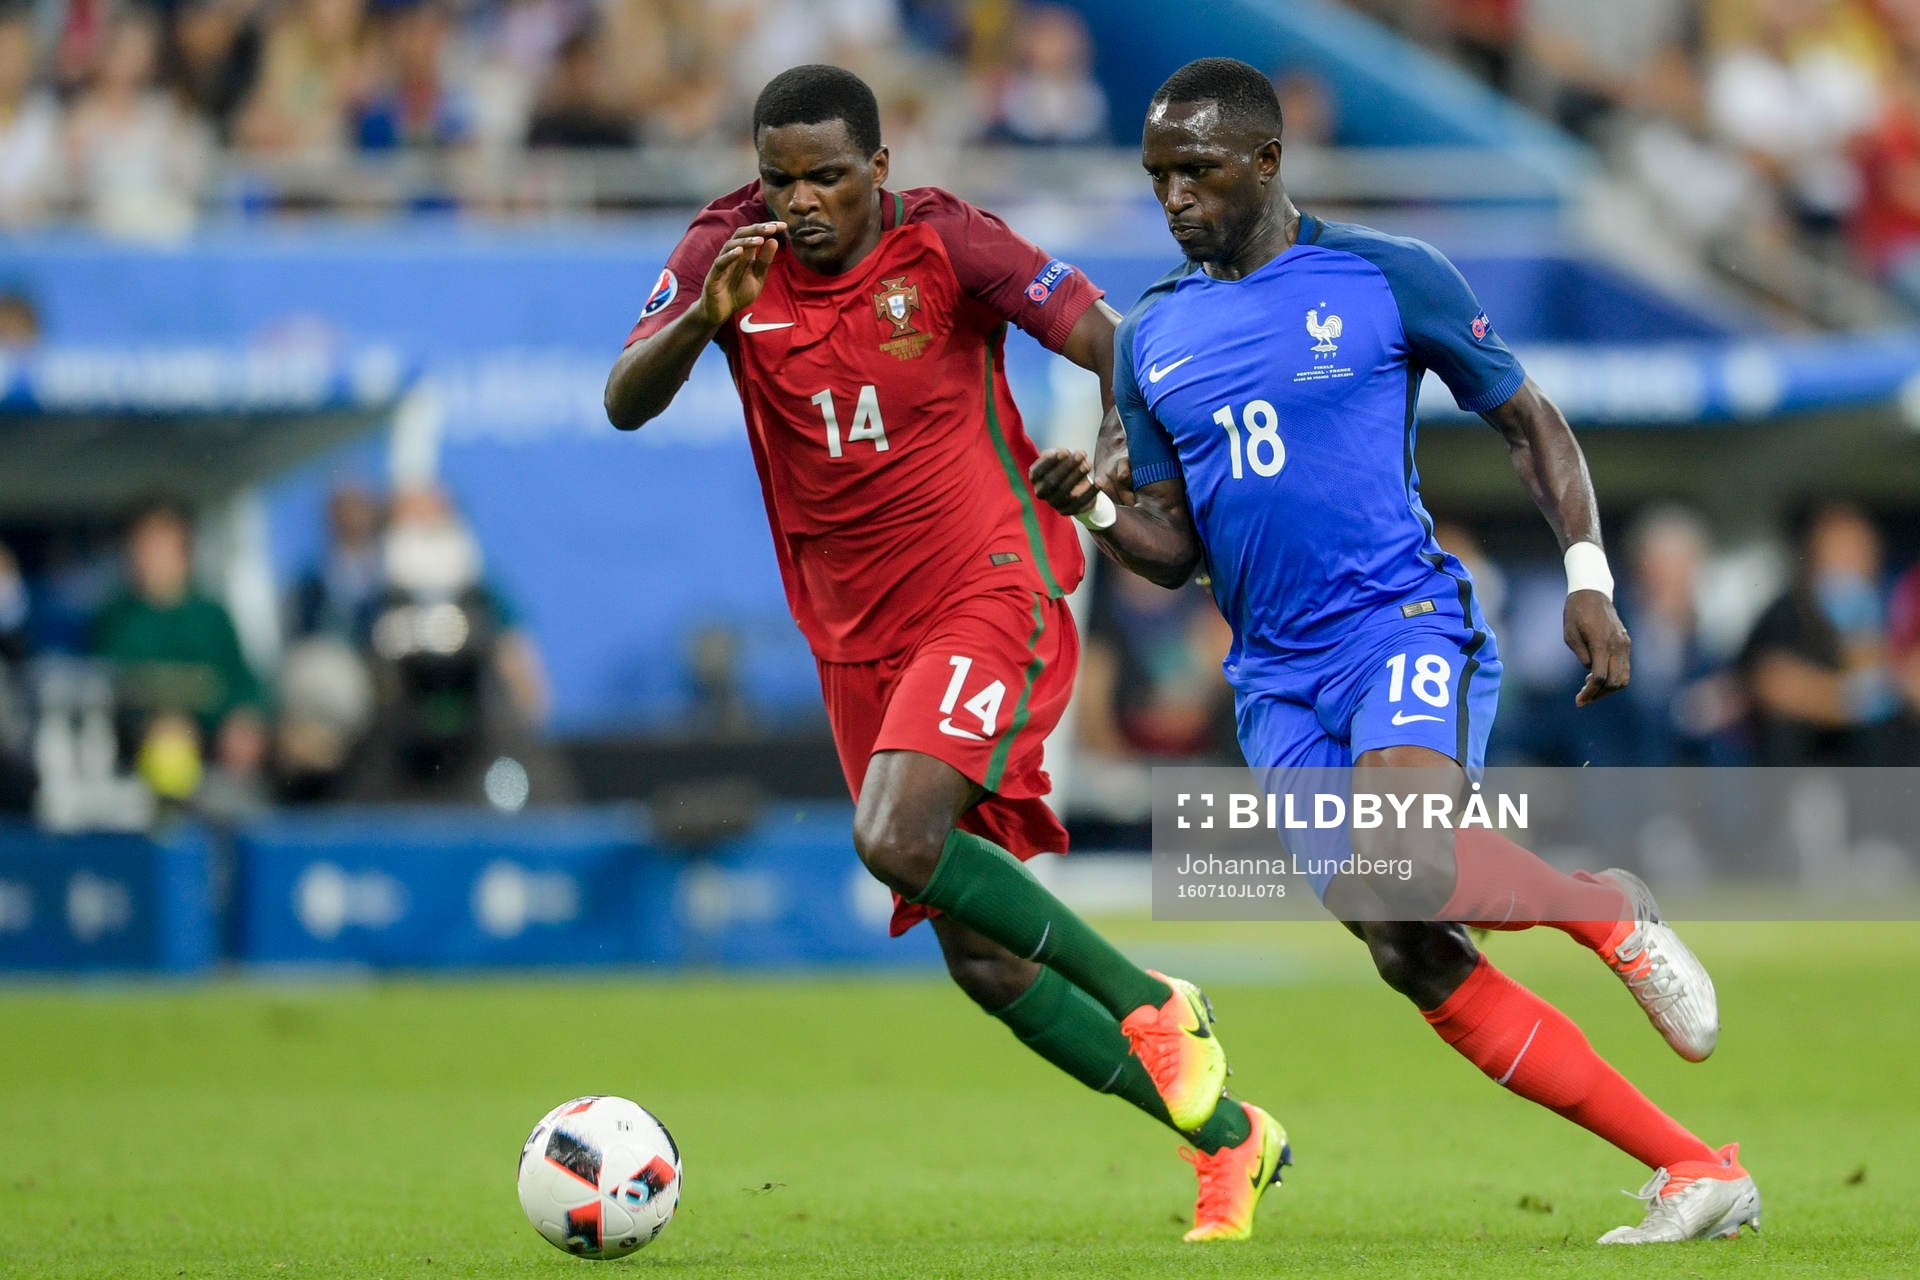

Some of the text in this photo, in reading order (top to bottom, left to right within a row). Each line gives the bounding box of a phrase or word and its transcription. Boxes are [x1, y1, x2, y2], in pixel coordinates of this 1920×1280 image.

[811, 384, 890, 458] 14
[1212, 399, 1286, 479] 18
[938, 655, 1007, 737] 14
[1385, 652, 1451, 708] 18
